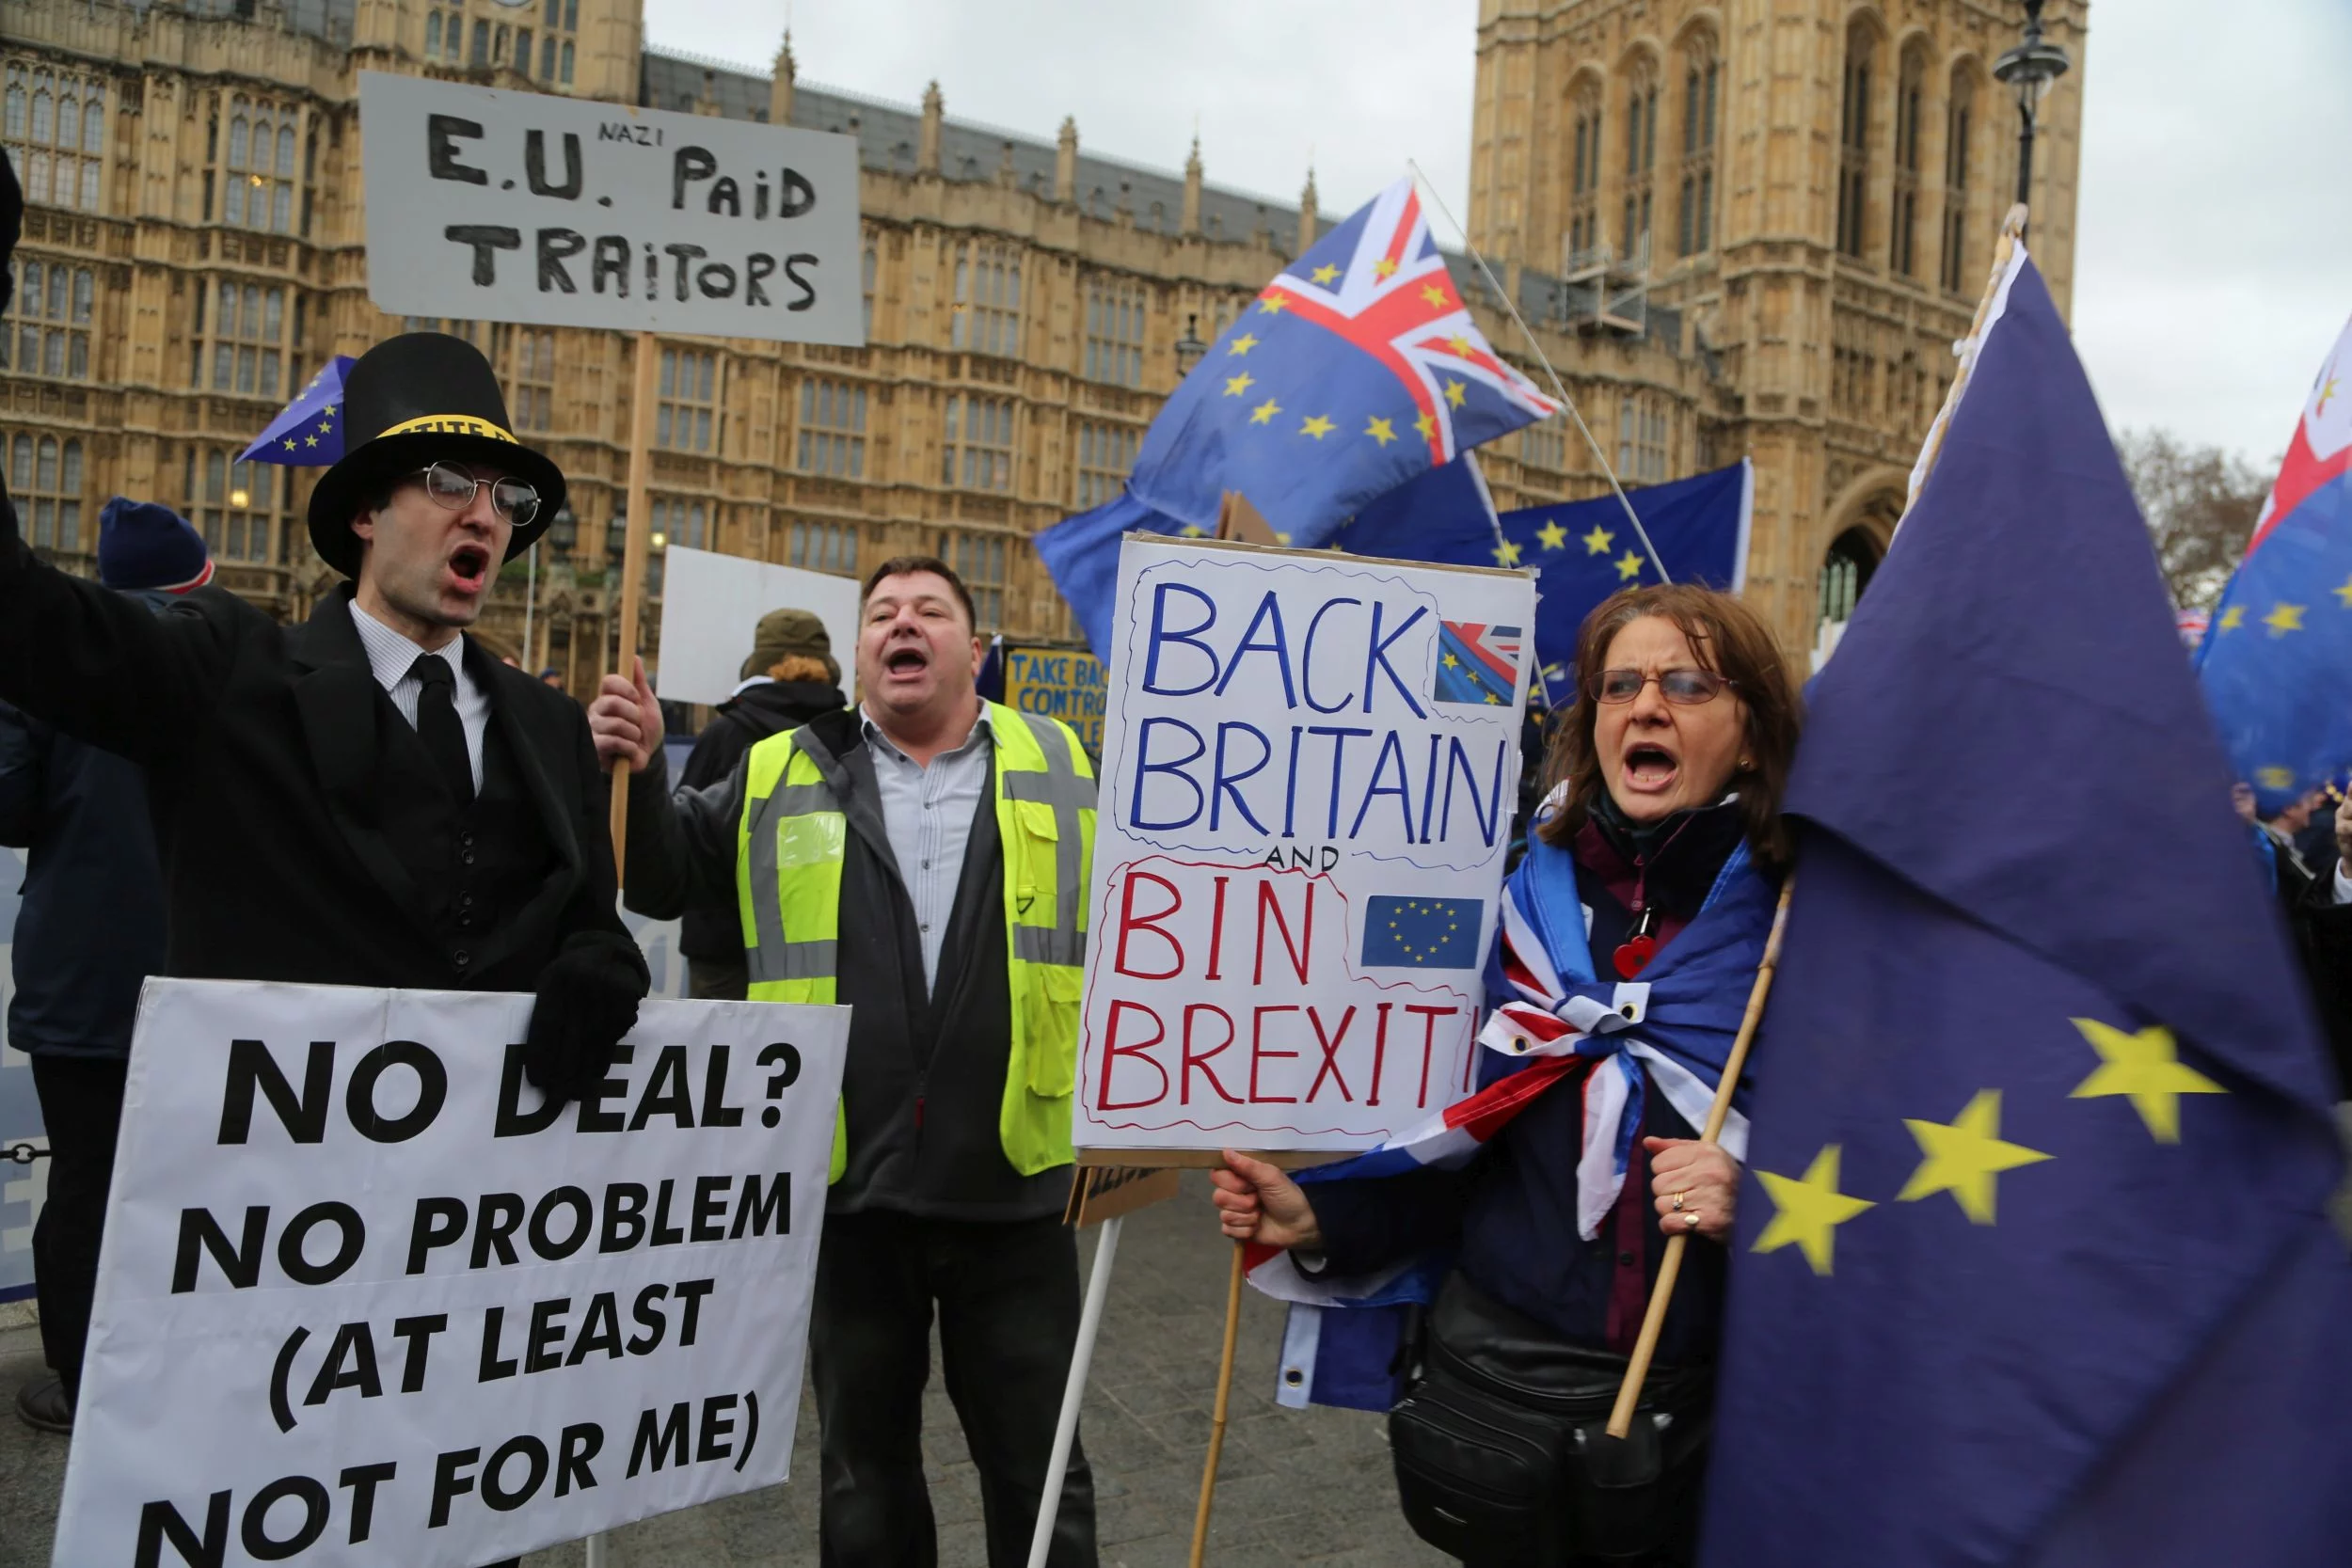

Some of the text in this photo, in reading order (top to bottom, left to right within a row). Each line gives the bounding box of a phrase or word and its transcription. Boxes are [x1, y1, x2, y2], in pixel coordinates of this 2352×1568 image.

[427, 114, 612, 207] E.U.
[598, 121, 663, 147] NAZI
[1011, 655, 1108, 687] TAKE BAC
[1019, 687, 1106, 716] CONTRO
[1142, 583, 1428, 719] BACK
[1130, 717, 1505, 847] BRITAIN
[1263, 846, 1339, 872] AND
[1115, 871, 1314, 986] BIN
[217, 1039, 802, 1146] NO DEAL?
[171, 1172, 791, 1295] NO PROBLEM
[269, 1278, 715, 1434] (AT LEAST
[135, 1390, 759, 1568] NOT FOR ME)
